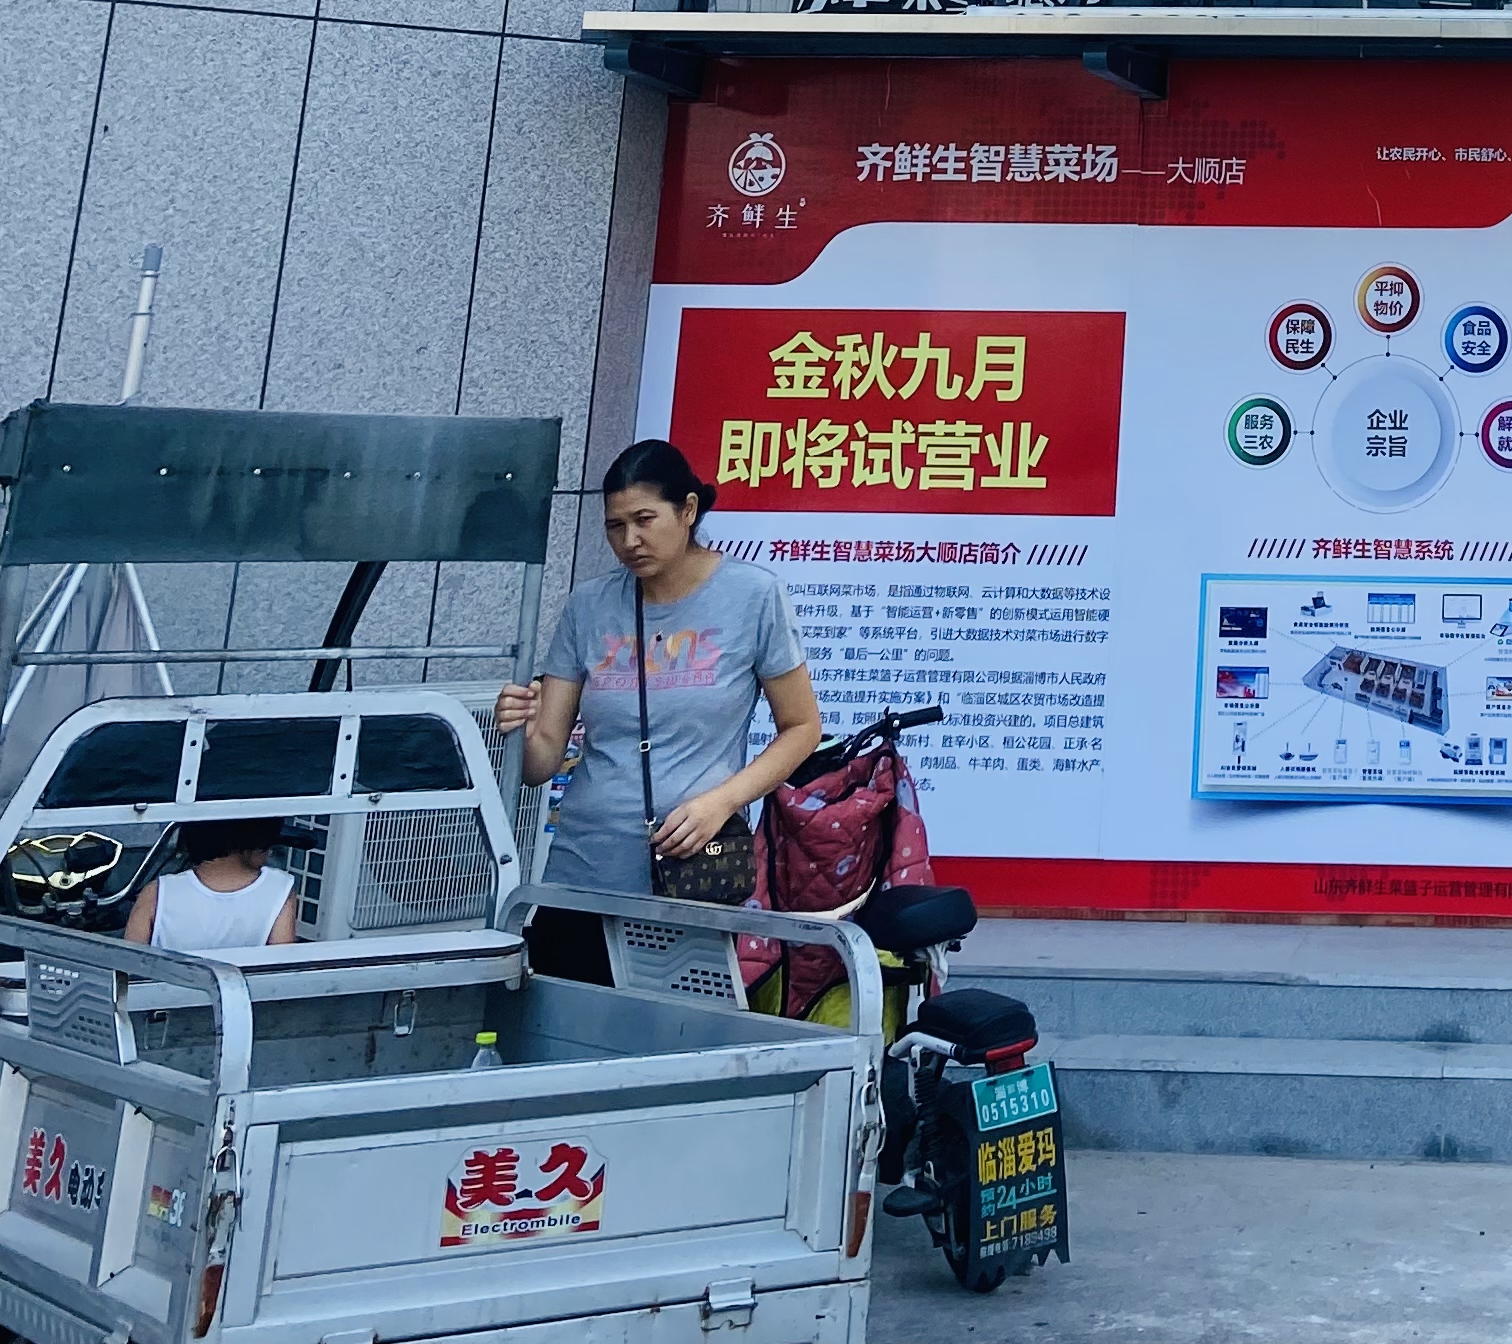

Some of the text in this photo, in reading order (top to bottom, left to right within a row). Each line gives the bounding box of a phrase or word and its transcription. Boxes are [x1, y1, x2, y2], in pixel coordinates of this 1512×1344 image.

[706, 203, 798, 229] 齐鲜生
[1373, 280, 1404, 297] 平抑
[1373, 300, 1404, 317] 物价
[1285, 318, 1316, 335] 保障
[1462, 320, 1492, 337] 食品
[1285, 338, 1316, 355] 民生
[1461, 340, 1492, 356] 安全
[766, 330, 1028, 403] 金秋九月
[1243, 414, 1275, 431] 服务
[1366, 408, 1410, 432] 企业
[1243, 434, 1275, 451] 三农
[1365, 434, 1409, 458] 宗旨
[716, 418, 1050, 492] 即将试营业
[769, 539, 1022, 564] 齐鲜生智慧菜场大顺店简介
[1311, 538, 1455, 561] 齐鲜生智慧系统
[981, 1088, 1051, 1124] 0515310
[457, 1142, 595, 1211] 美久
[460, 1213, 582, 1237] Electrombile
